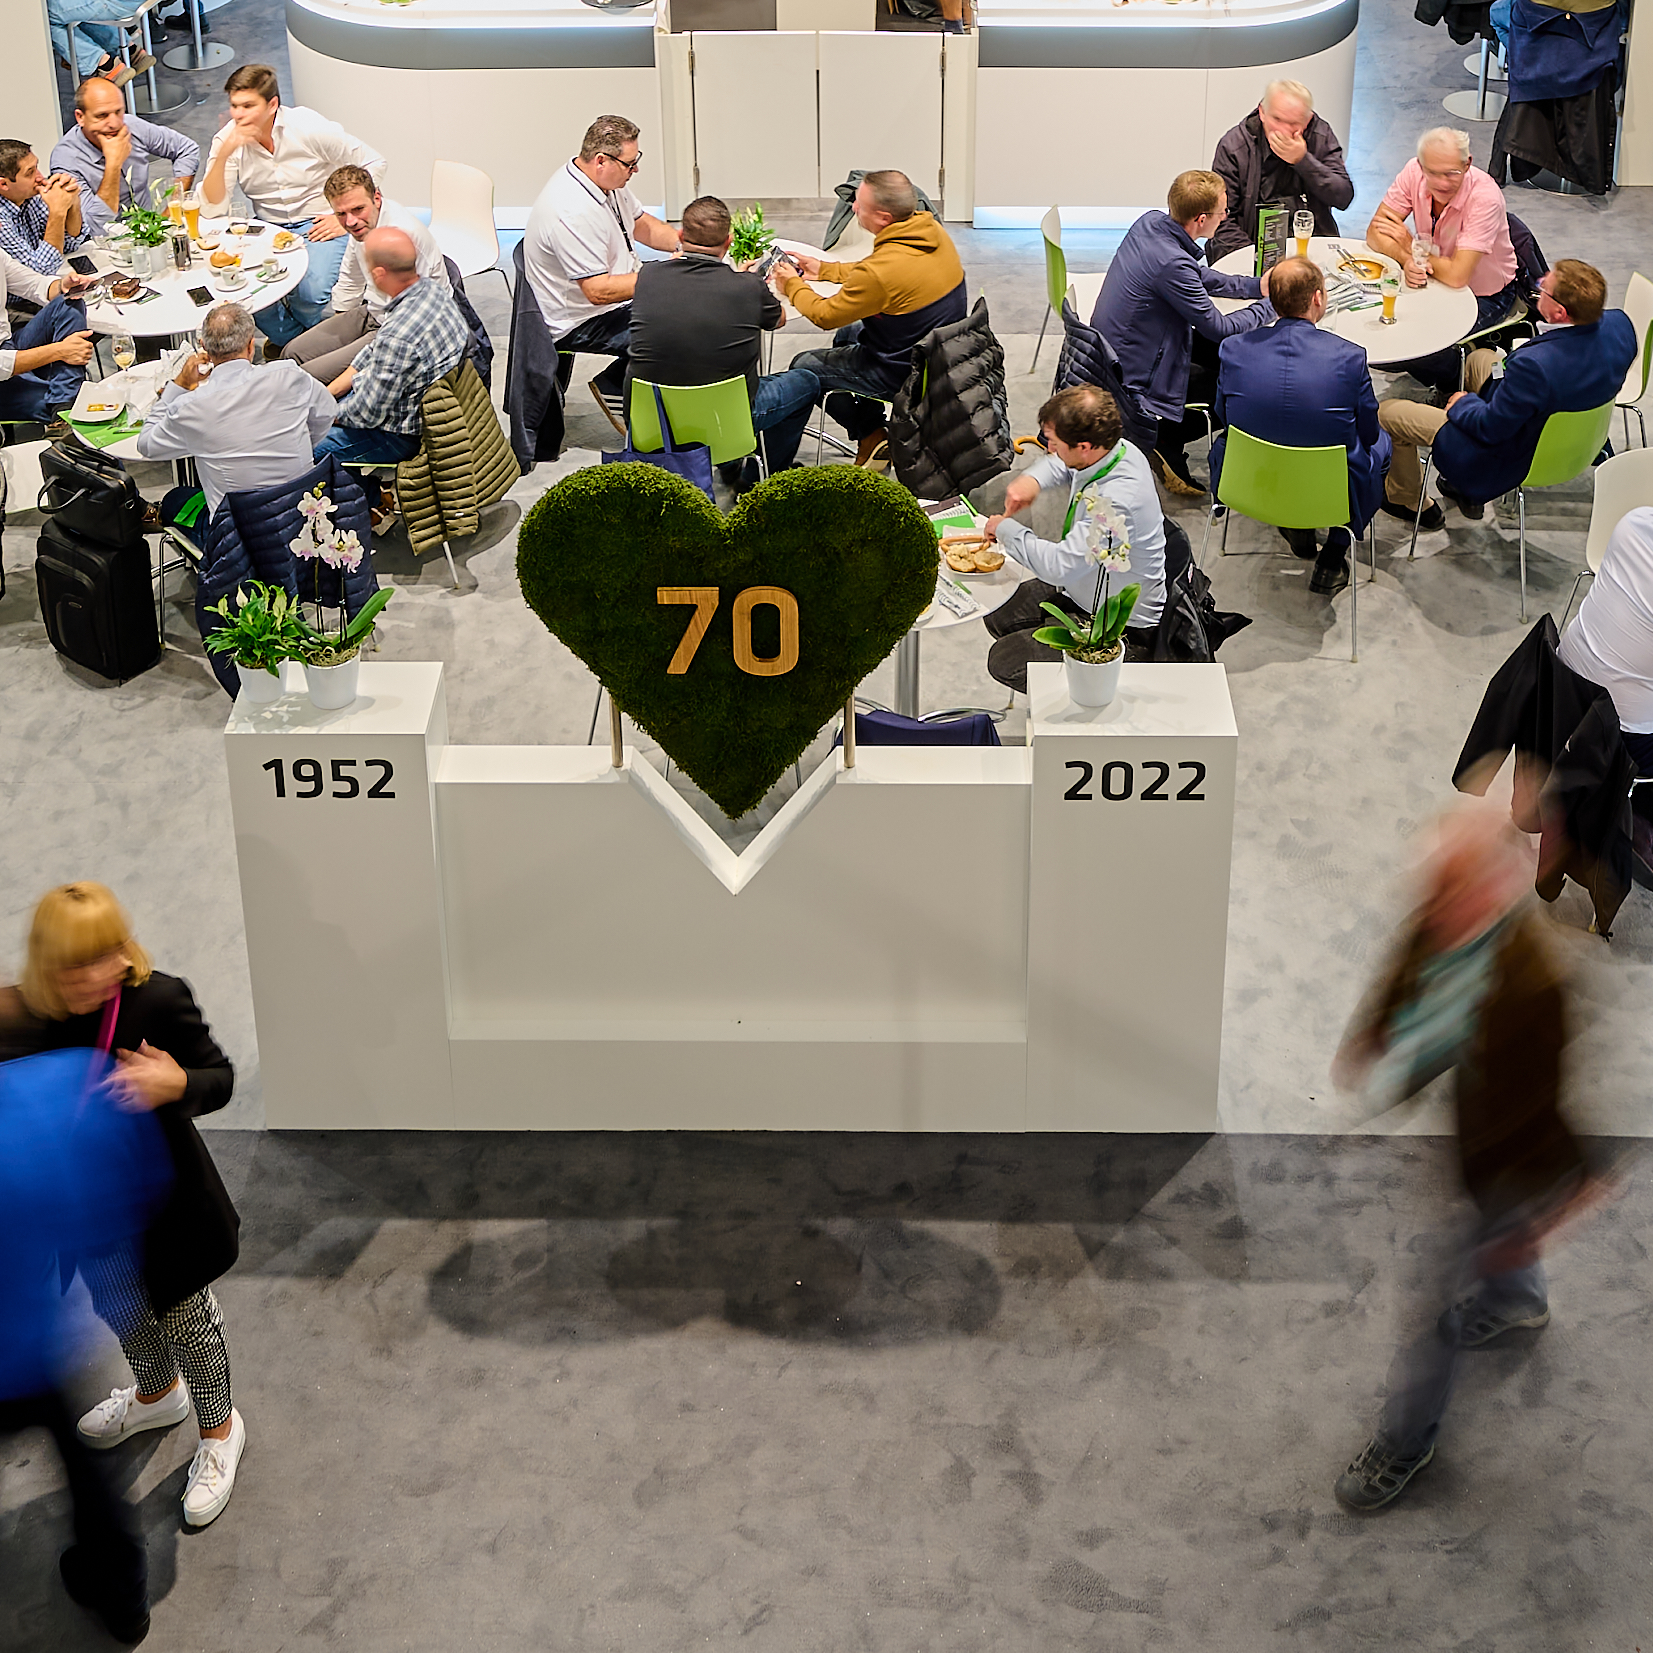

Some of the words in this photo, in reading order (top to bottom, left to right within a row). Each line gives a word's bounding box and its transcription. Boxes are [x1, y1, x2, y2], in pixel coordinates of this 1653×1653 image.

[655, 585, 800, 677] 70
[261, 757, 397, 800] 1952
[1062, 759, 1207, 802] 2022
